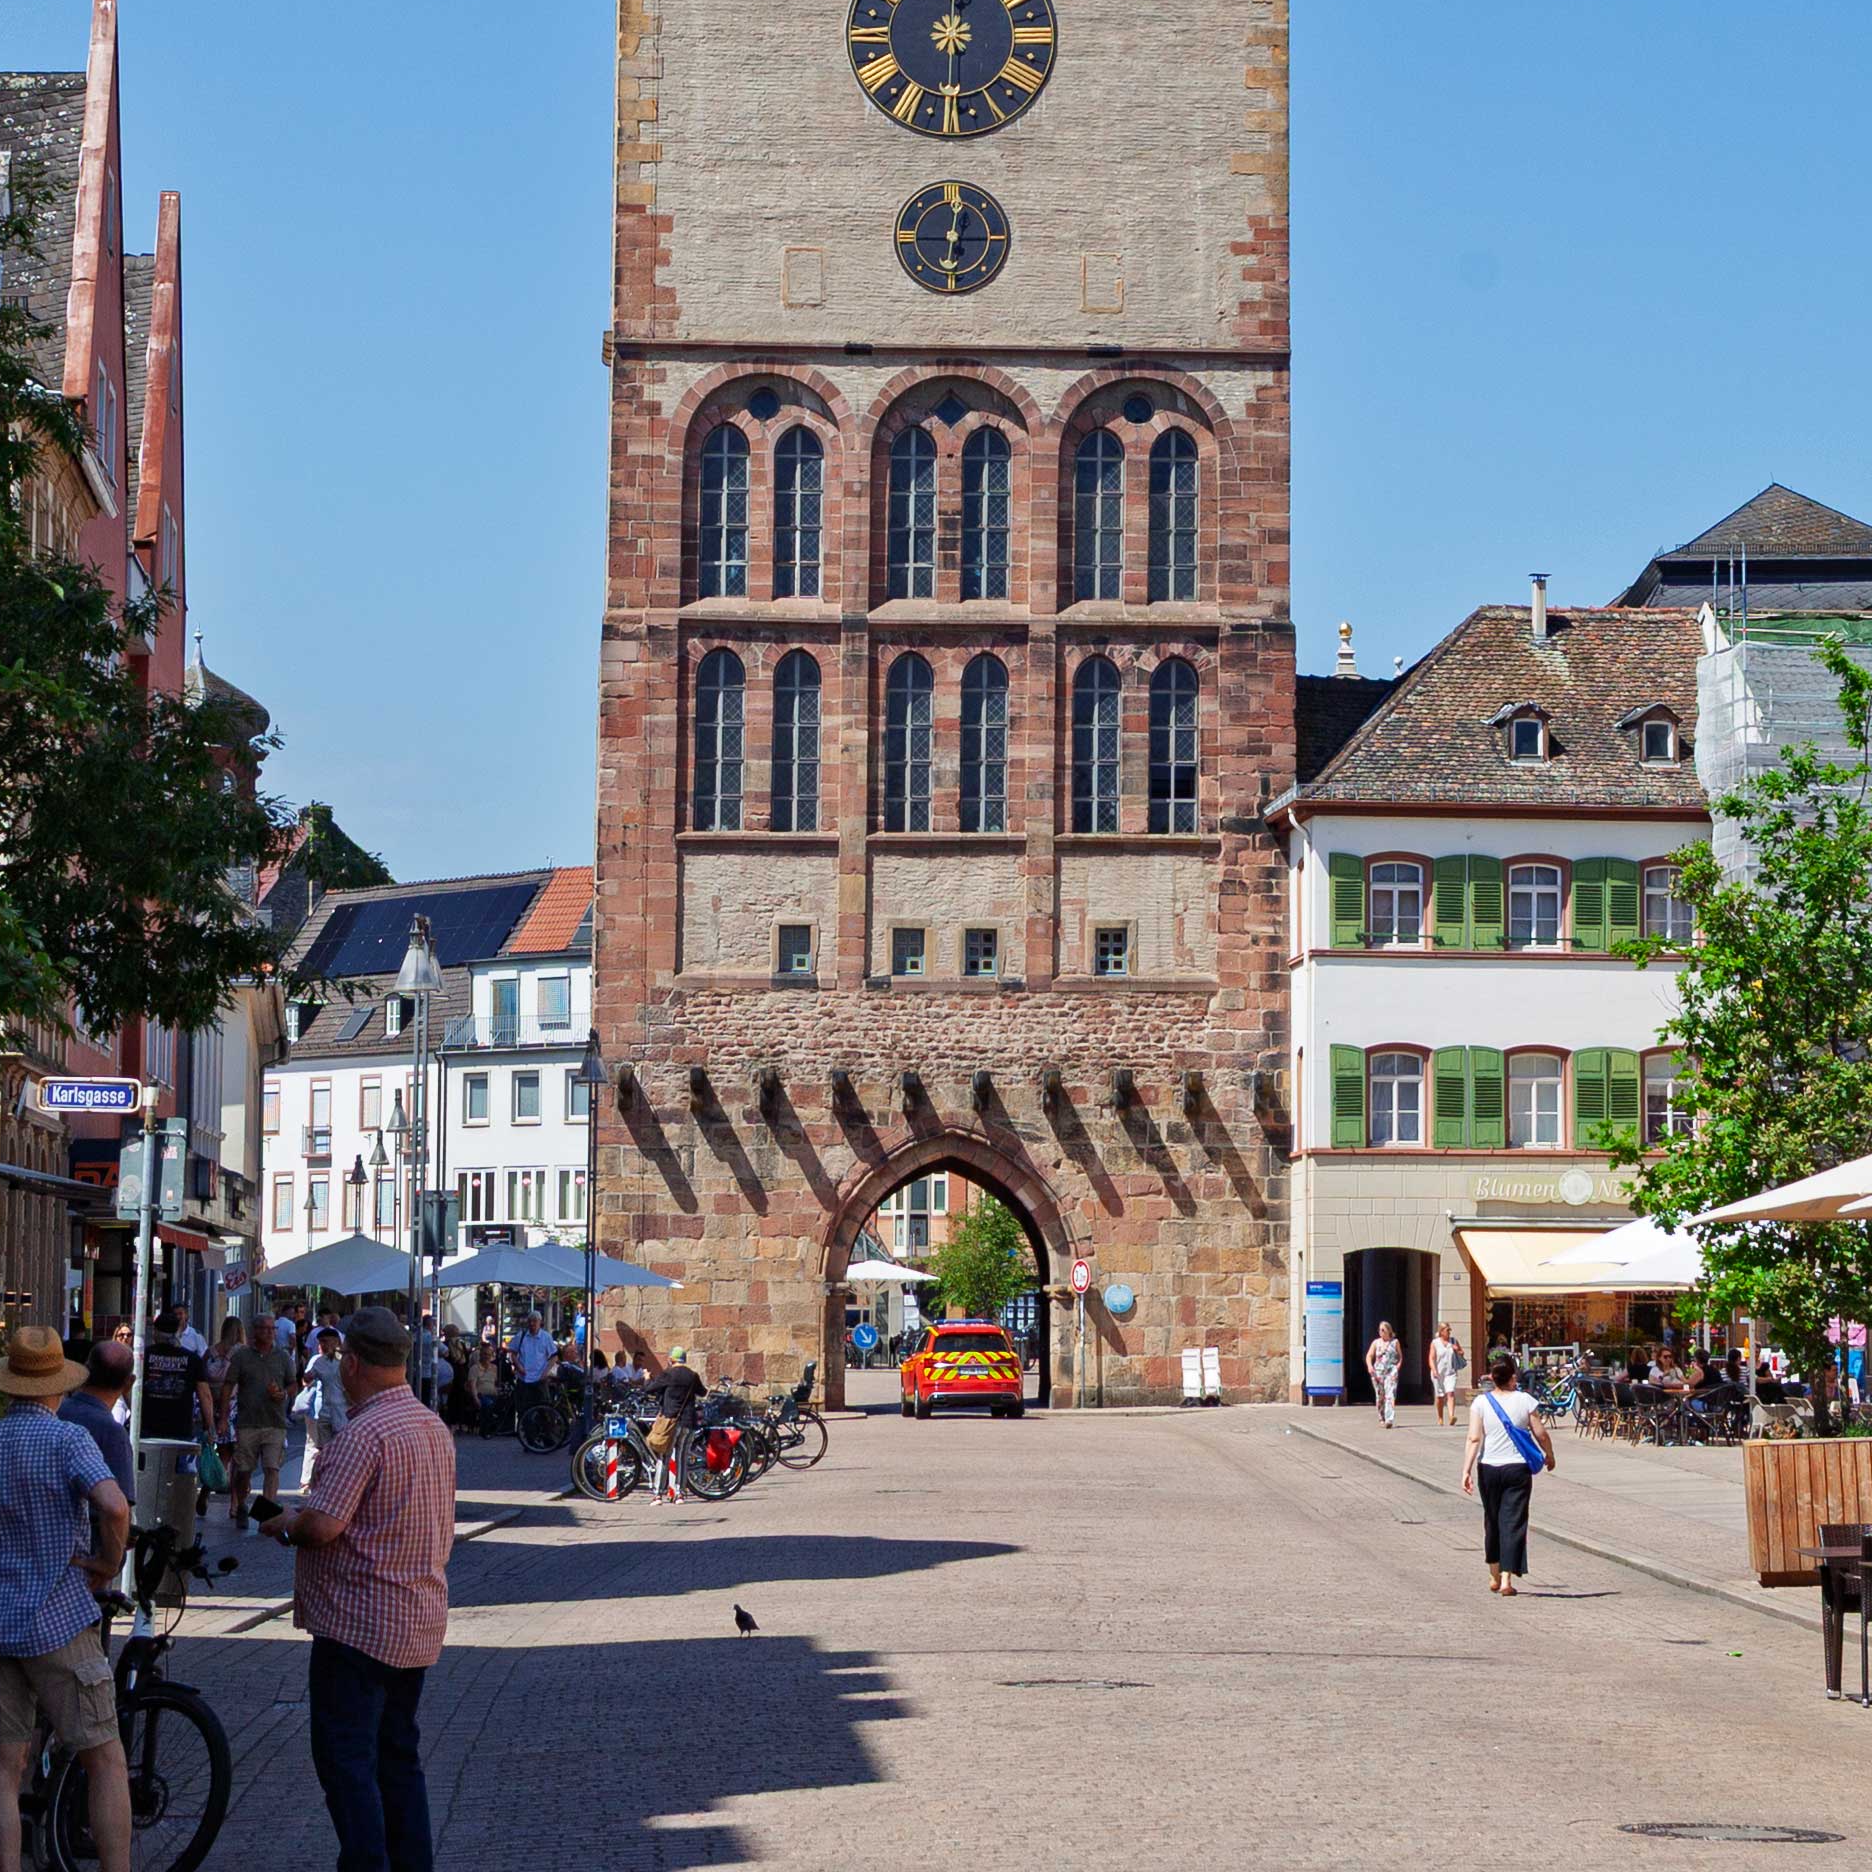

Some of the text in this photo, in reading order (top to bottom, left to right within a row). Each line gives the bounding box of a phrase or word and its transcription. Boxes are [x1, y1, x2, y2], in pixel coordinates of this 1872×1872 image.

[52, 1085, 126, 1106] Karlsgasse
[1476, 1178, 1556, 1200] Blumen
[609, 1419, 620, 1434] P
